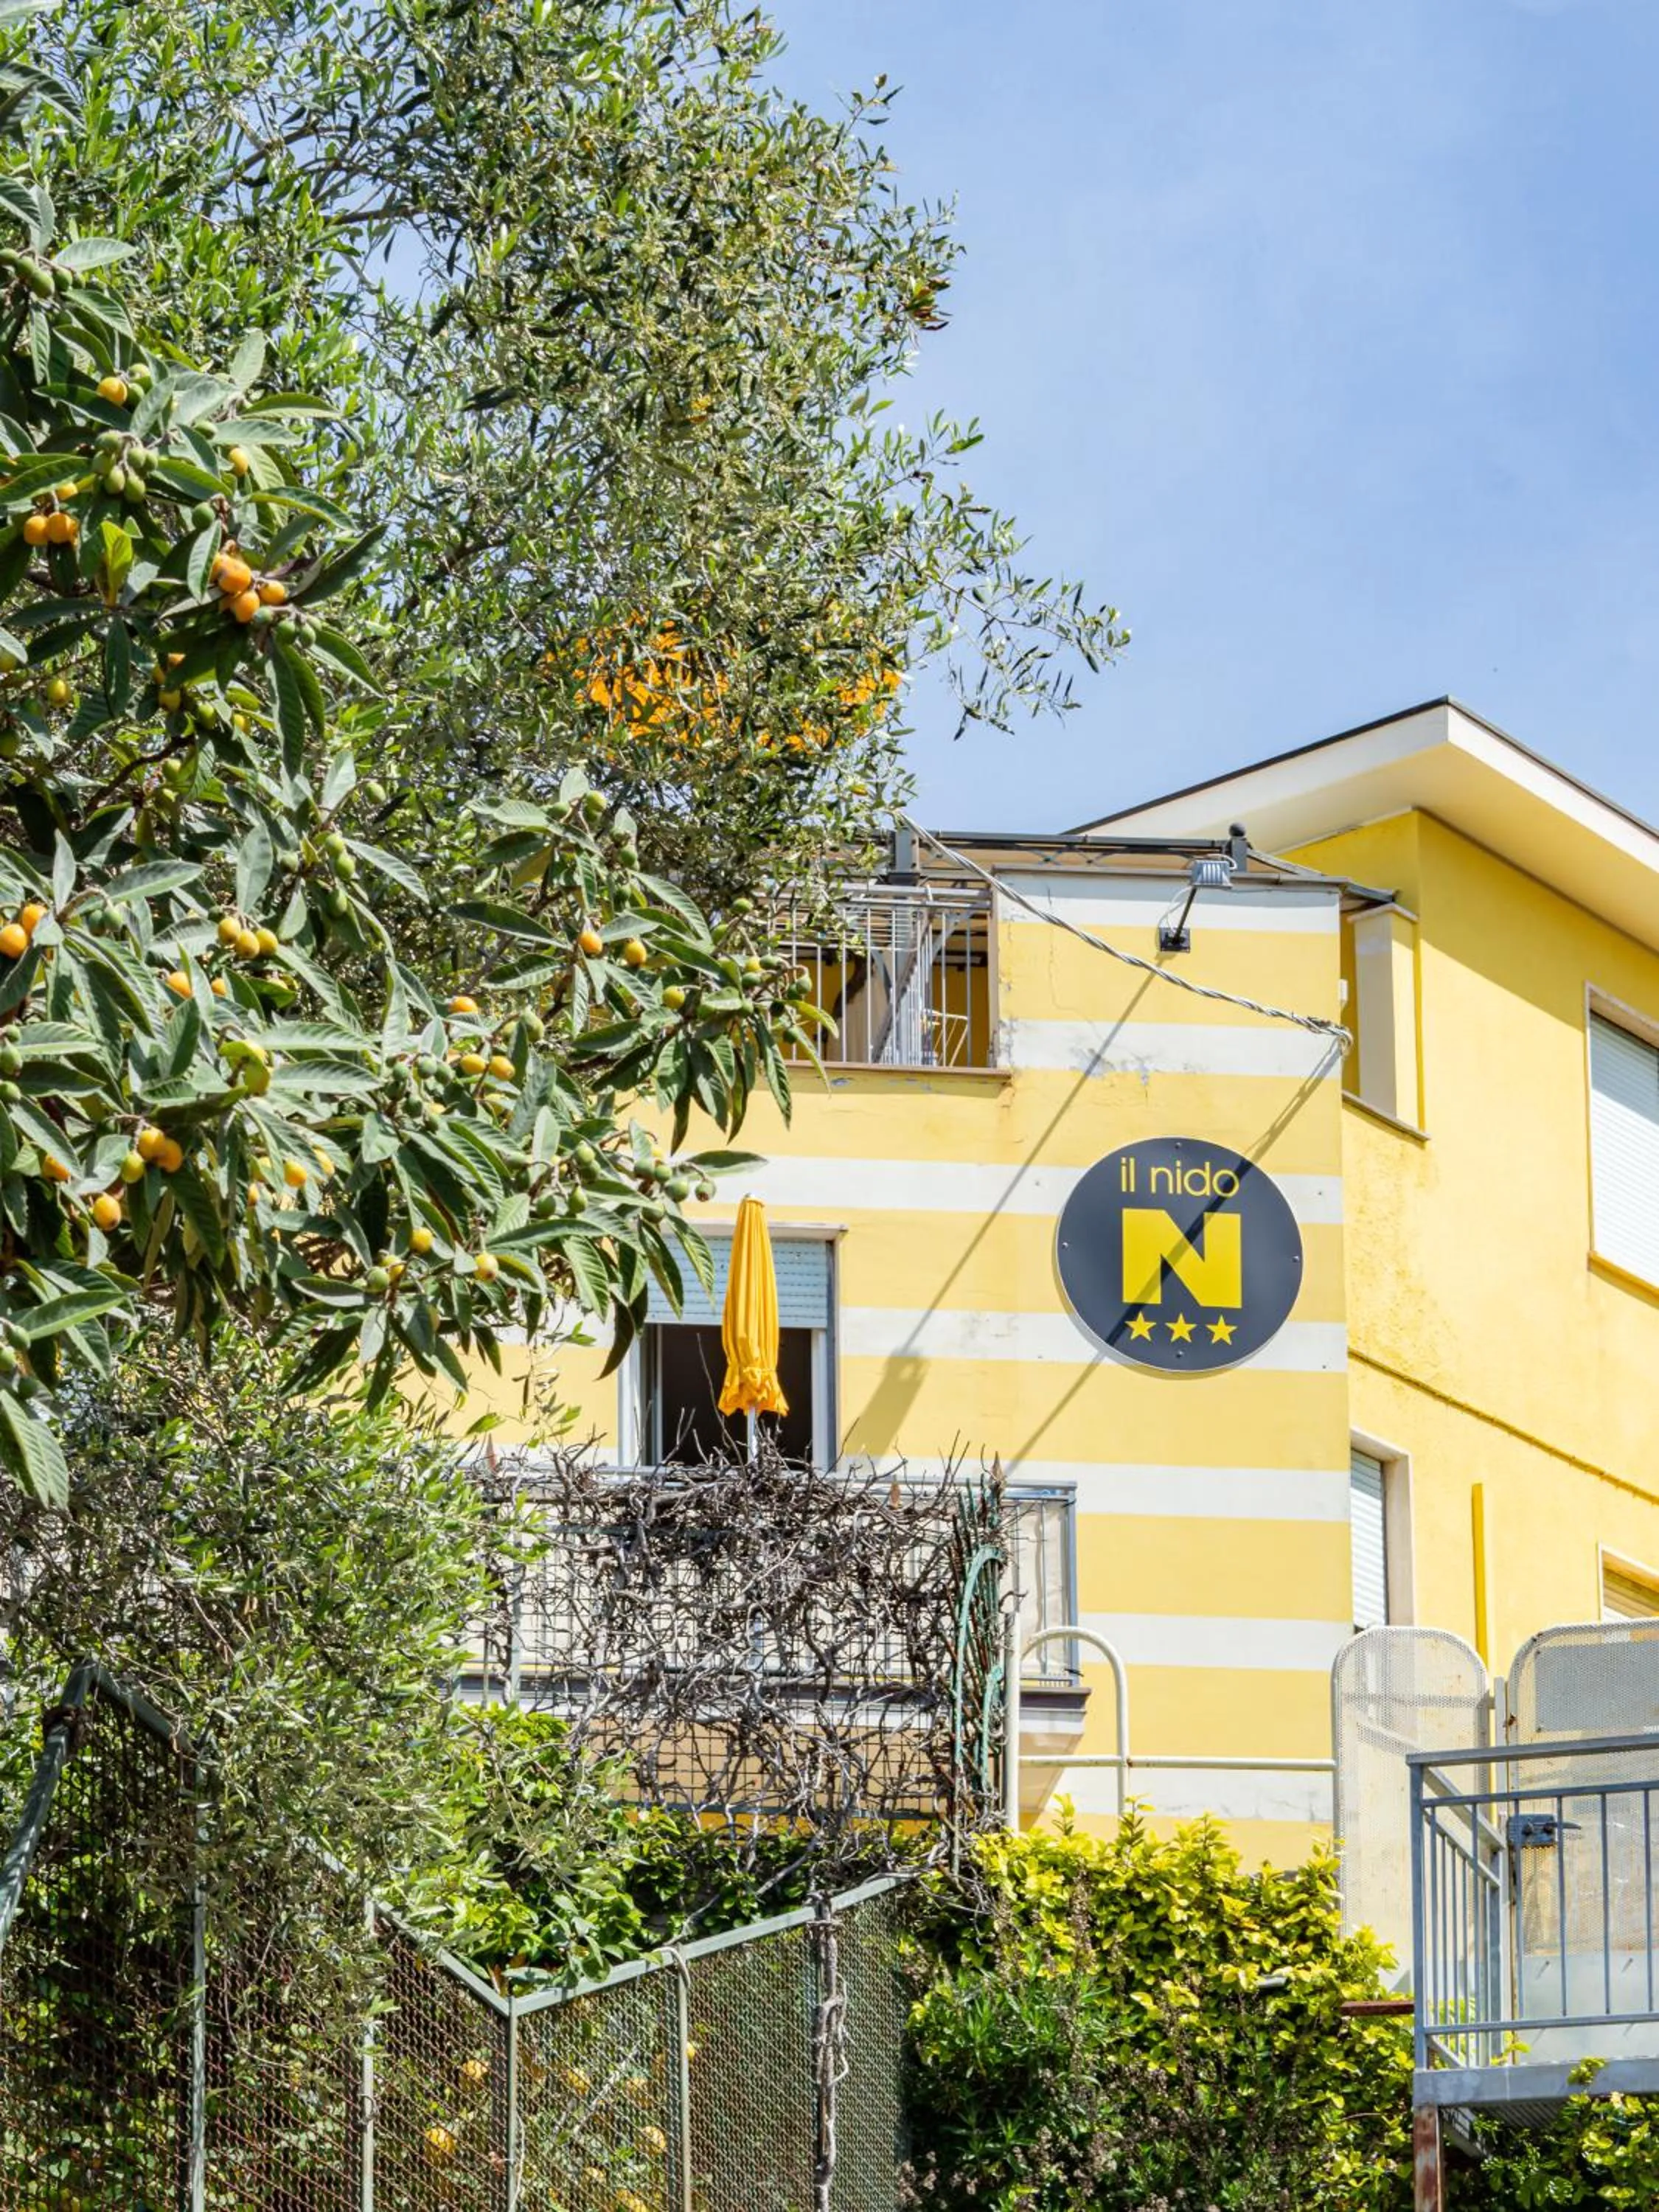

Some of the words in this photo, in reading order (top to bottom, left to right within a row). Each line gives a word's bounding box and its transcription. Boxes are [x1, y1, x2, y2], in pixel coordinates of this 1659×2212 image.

[1121, 1157, 1135, 1192] il
[1150, 1160, 1239, 1197] nido
[1121, 1208, 1242, 1309] N
